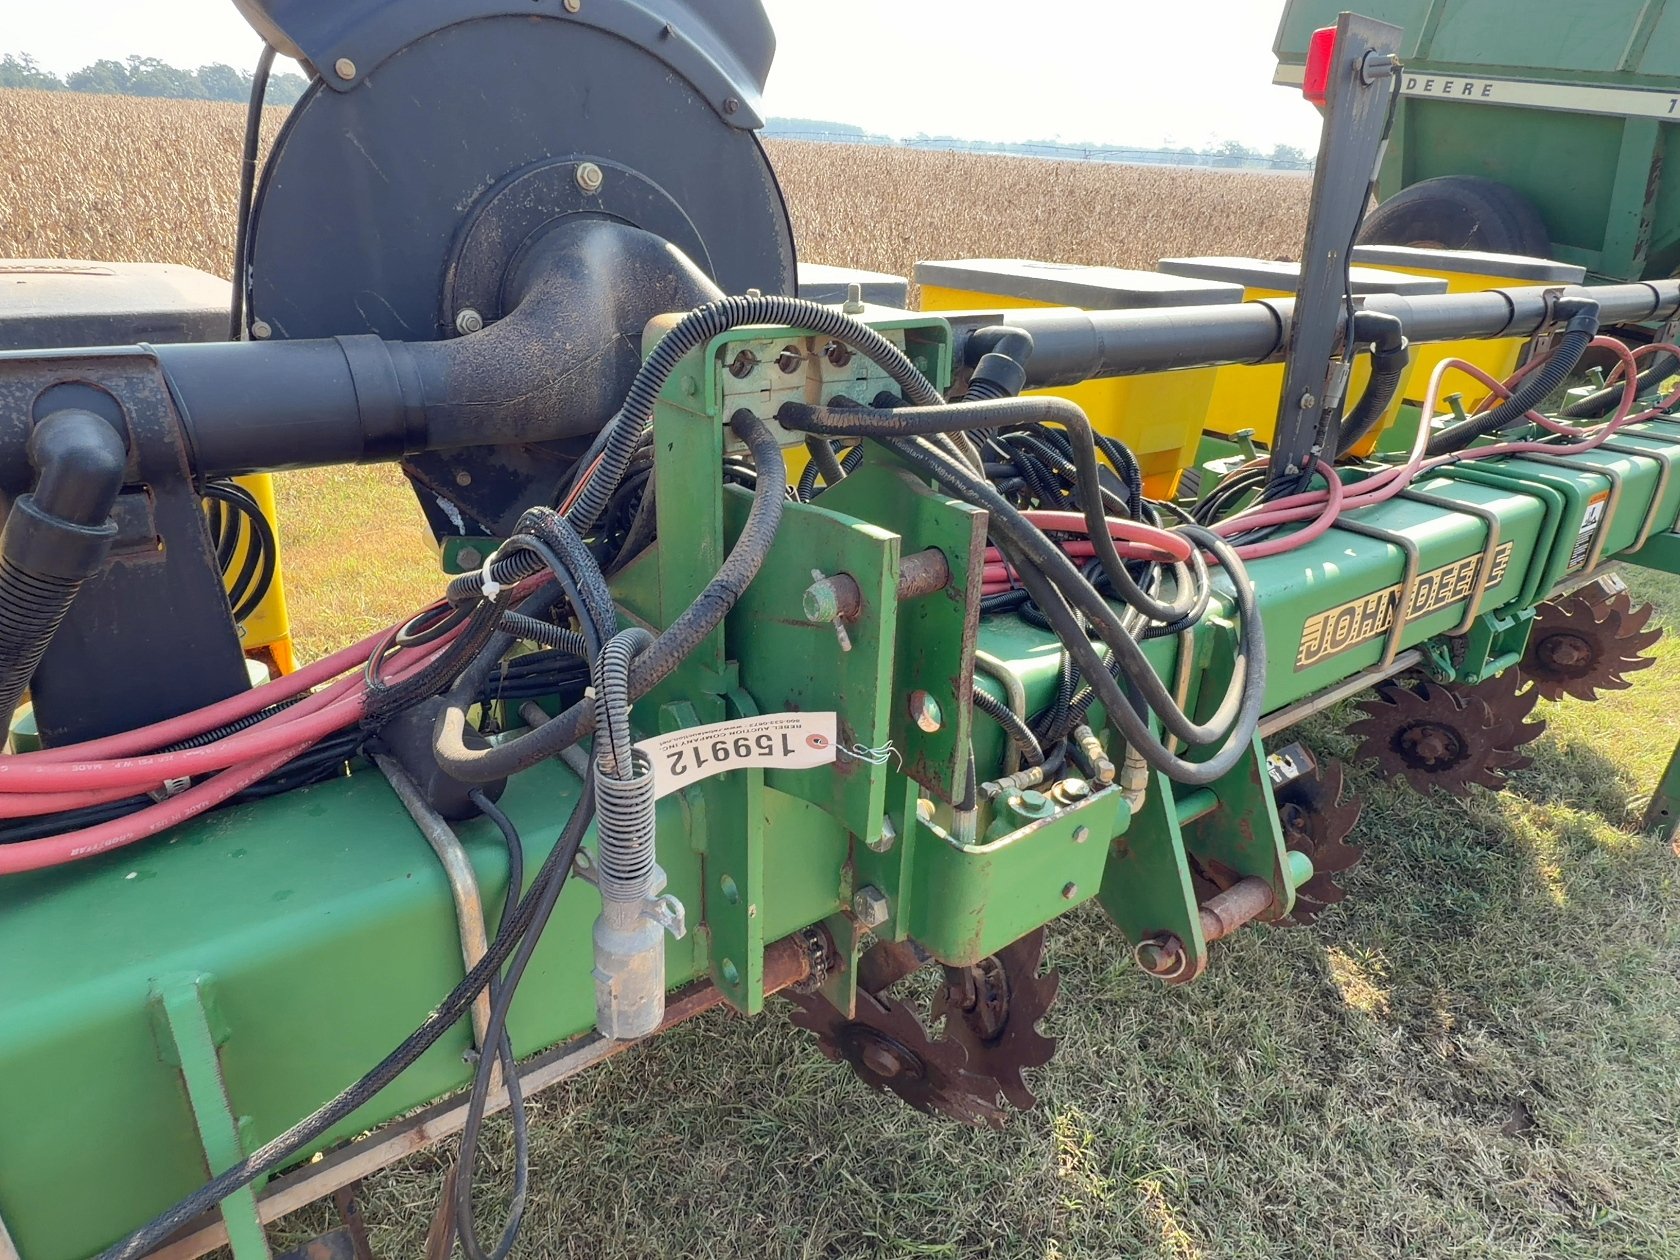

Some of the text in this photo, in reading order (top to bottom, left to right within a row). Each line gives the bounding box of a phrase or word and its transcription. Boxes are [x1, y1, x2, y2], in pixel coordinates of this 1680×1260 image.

[1405, 77, 1494, 99] DEERE
[658, 723, 802, 752] REBEL AUCTION COMPANY INC.
[666, 732, 796, 777] 159912
[71, 763, 102, 772] MADE
[184, 800, 210, 815] MADE
[149, 817, 168, 830] USA
